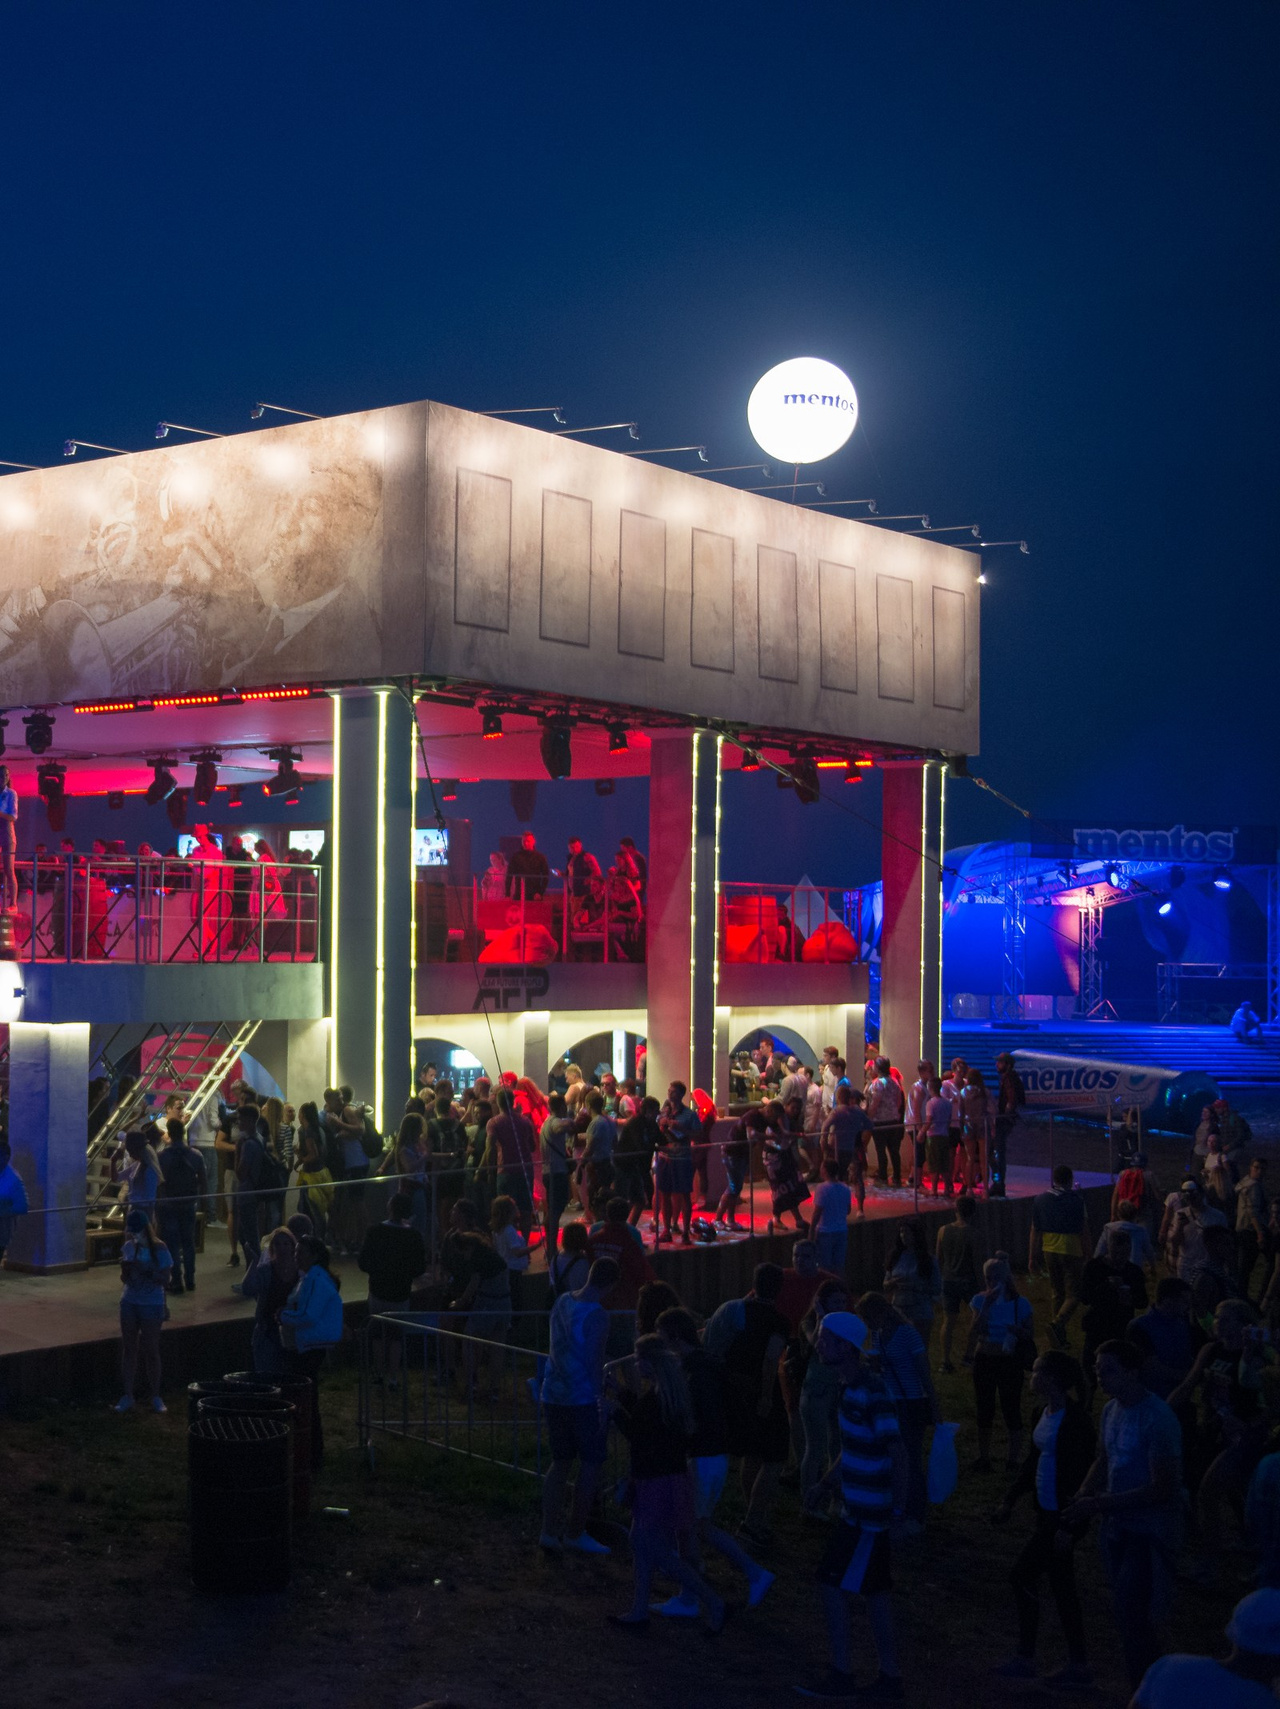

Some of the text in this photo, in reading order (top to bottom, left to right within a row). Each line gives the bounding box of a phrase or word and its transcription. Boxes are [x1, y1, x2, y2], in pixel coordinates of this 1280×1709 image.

[783, 393, 855, 414] mentos
[1073, 825, 1234, 862] mentos
[472, 967, 549, 1010] AFP
